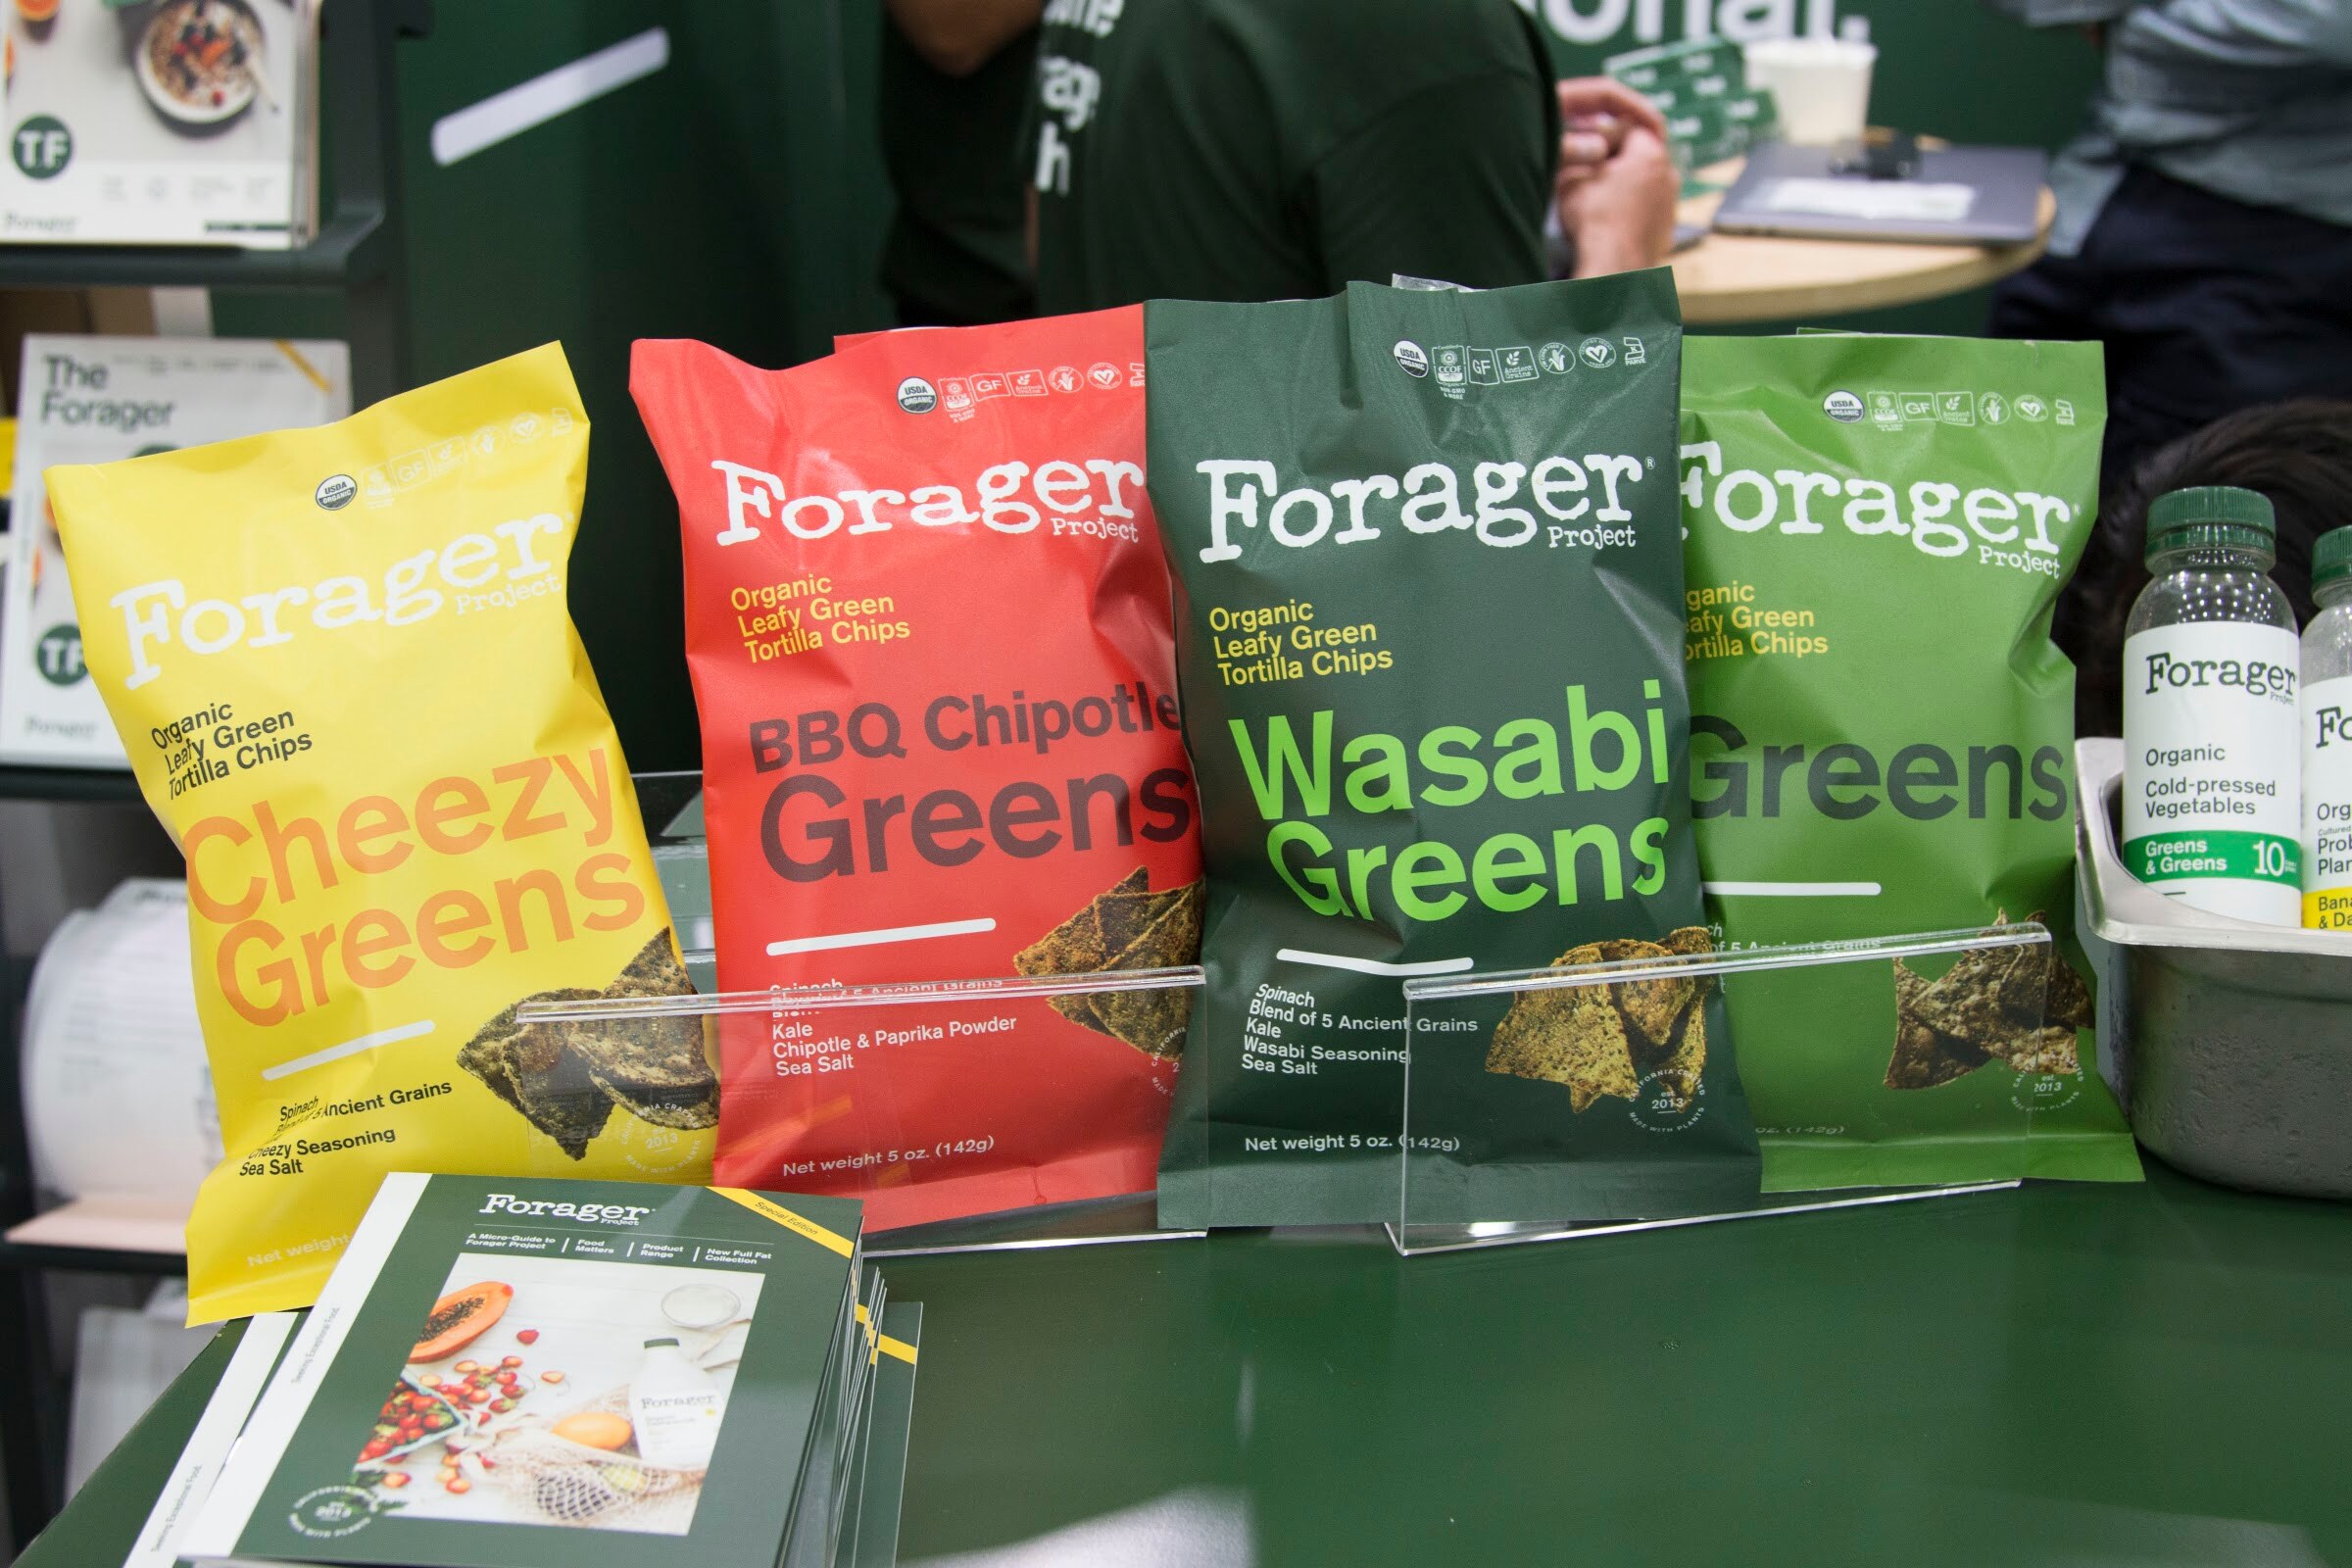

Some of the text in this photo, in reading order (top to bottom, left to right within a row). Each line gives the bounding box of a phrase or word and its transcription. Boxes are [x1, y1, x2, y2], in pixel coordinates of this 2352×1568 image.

[19, 130, 69, 169] TF
[1399, 348, 1421, 361] USDA
[1399, 358, 1426, 371] ORGANIC
[1472, 360, 1492, 375] GF
[42, 354, 110, 391] The
[976, 379, 1003, 392] GF
[904, 397, 934, 407] ORGANIC
[905, 386, 928, 396] USDA
[41, 394, 175, 432] Forager
[1831, 409, 1860, 417] ORGANIC
[1906, 403, 1931, 414] GF
[322, 489, 352, 504] ORGANIC
[324, 481, 348, 495] USDA
[1680, 441, 2071, 558] Forager
[710, 459, 1144, 547] Forager
[1196, 454, 1643, 564] Forager
[1053, 517, 1139, 543] Project
[1547, 526, 1637, 550] Project
[1978, 544, 2061, 579] Project
[110, 513, 564, 690] Forager
[455, 572, 563, 615] Project
[730, 573, 833, 612] Organic
[1686, 580, 1755, 612] ganic
[738, 596, 895, 637] Leafy Green
[1209, 599, 1314, 632] Organic
[1686, 605, 1815, 637] afy Green
[744, 619, 910, 663] Tortilla Chips
[1213, 623, 1377, 659] Leafy Green
[1686, 630, 1829, 661] ortilla Chips
[1217, 648, 1394, 686] Tortilla Chips
[2145, 652, 2295, 696] Forager
[151, 702, 233, 750] Organic
[749, 680, 1182, 774] BBQ Chipotle
[165, 710, 295, 775] Leafy Green
[1227, 679, 1669, 820] Wasabi
[2145, 743, 2226, 766] Organic
[169, 733, 313, 800] Tortilla Chips
[1690, 714, 2068, 821] Greens
[2145, 777, 2276, 798] Cold-pressed
[2145, 797, 2256, 818] Vegetables
[182, 748, 613, 924] Cheezy
[760, 767, 1191, 883] Greens
[2145, 839, 2208, 857] Greens
[2252, 840, 2285, 877] 10
[1267, 817, 1669, 921] Greens
[2145, 857, 2228, 875] & Greens
[2319, 915, 2328, 929] &
[216, 853, 646, 1027] Greens
[1255, 983, 1315, 1007] Spinach
[1246, 1016, 1282, 1039] Kale
[1249, 999, 1478, 1032] Blend of 5 Ancient Grains
[772, 1021, 813, 1040] Kale
[772, 1016, 1017, 1058] Chipotle & Paprika Powder
[1244, 1035, 1411, 1064] Wasabi Seasoning
[775, 1054, 855, 1077] Sea Salt
[1242, 1054, 1318, 1075] Sea Salt
[321, 1094, 385, 1117] Ancient
[389, 1082, 453, 1105] Grains
[2034, 1082, 2062, 1092] 2013
[279, 1096, 319, 1125] Spinach
[1651, 1098, 1684, 1109] 2013
[1629, 1112, 1648, 1129] MADE
[248, 1143, 292, 1159] Cheezy
[296, 1129, 396, 1155] Seasoning
[783, 1135, 995, 1176] Net weight 5 oz. (142g)
[1245, 1135, 1460, 1152] Net weight 5 oz. (142g)
[239, 1158, 304, 1176] Sea Salt
[478, 1194, 651, 1223] Forager
[755, 1201, 818, 1235] Special Edition
[247, 1234, 351, 1268] Net weight
[466, 1239, 546, 1250] Forager Project
[478, 1233, 542, 1244] Micro-Guide
[575, 1245, 614, 1254] Matters
[642, 1244, 684, 1252] Product
[640, 1250, 674, 1258] Range
[705, 1254, 758, 1265] Collection
